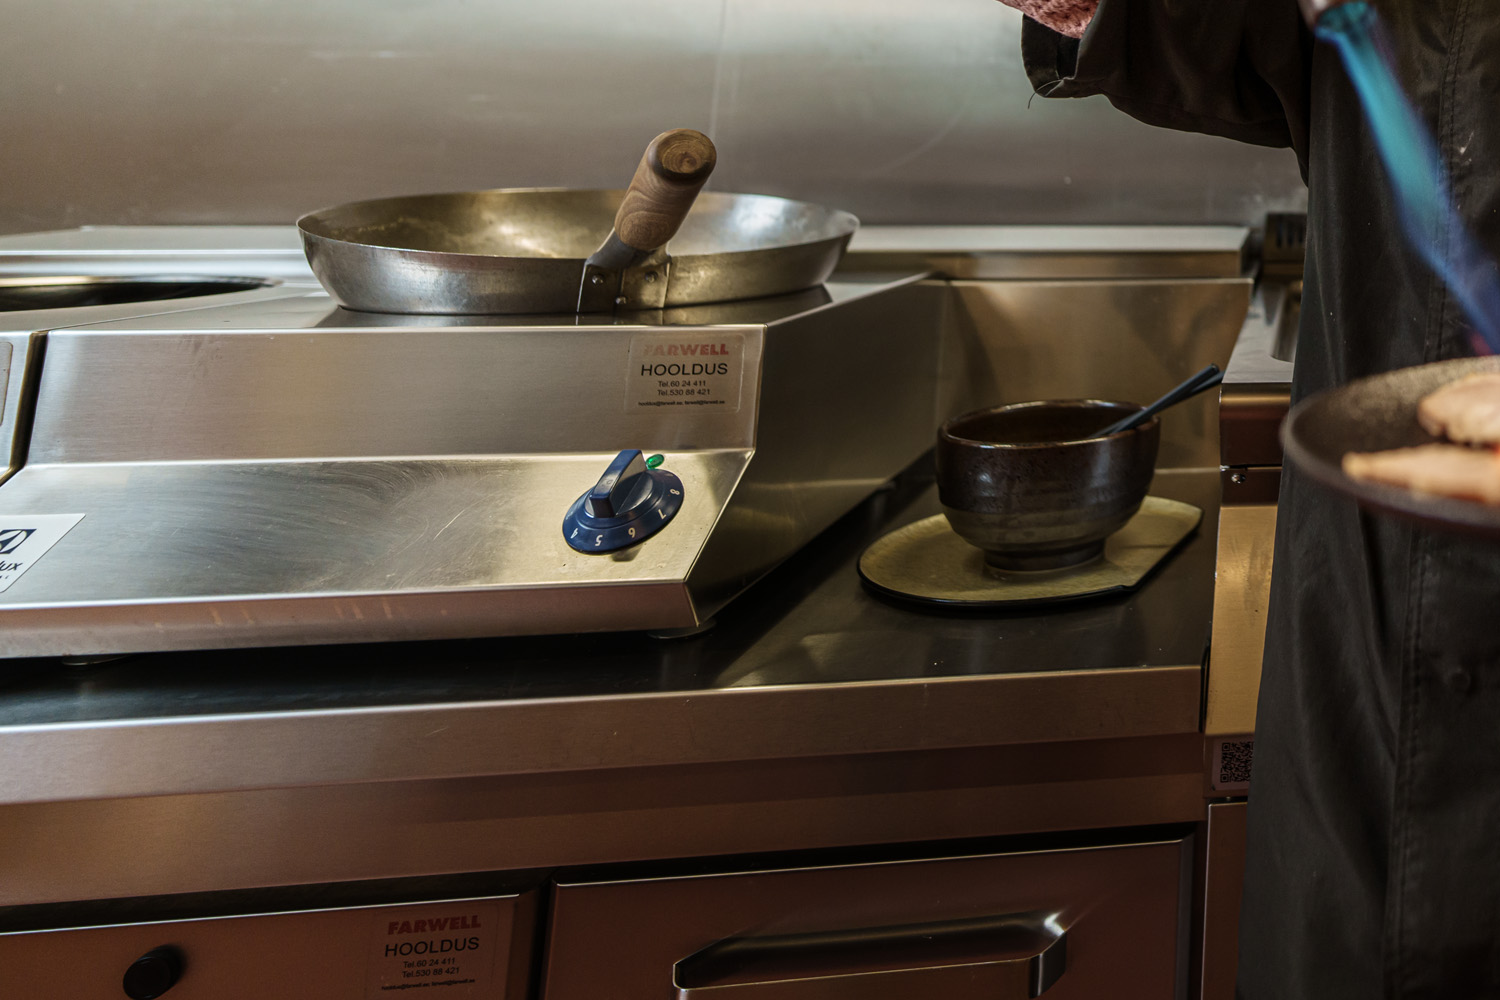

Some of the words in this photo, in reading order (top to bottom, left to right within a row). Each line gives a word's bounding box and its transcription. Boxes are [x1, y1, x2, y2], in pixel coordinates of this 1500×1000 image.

[644, 343, 729, 356] FARWELL
[640, 363, 728, 376] HOOLDUS
[697, 388, 711, 396] 421
[669, 488, 680, 496] 8
[658, 508, 667, 520] 7
[570, 527, 579, 539] 4
[594, 534, 603, 547] 5
[387, 915, 482, 935] FARWELL
[384, 936, 480, 957] HOOLDUS
[428, 958, 439, 967] 24
[441, 957, 456, 966] 411
[445, 967, 460, 975] 421
